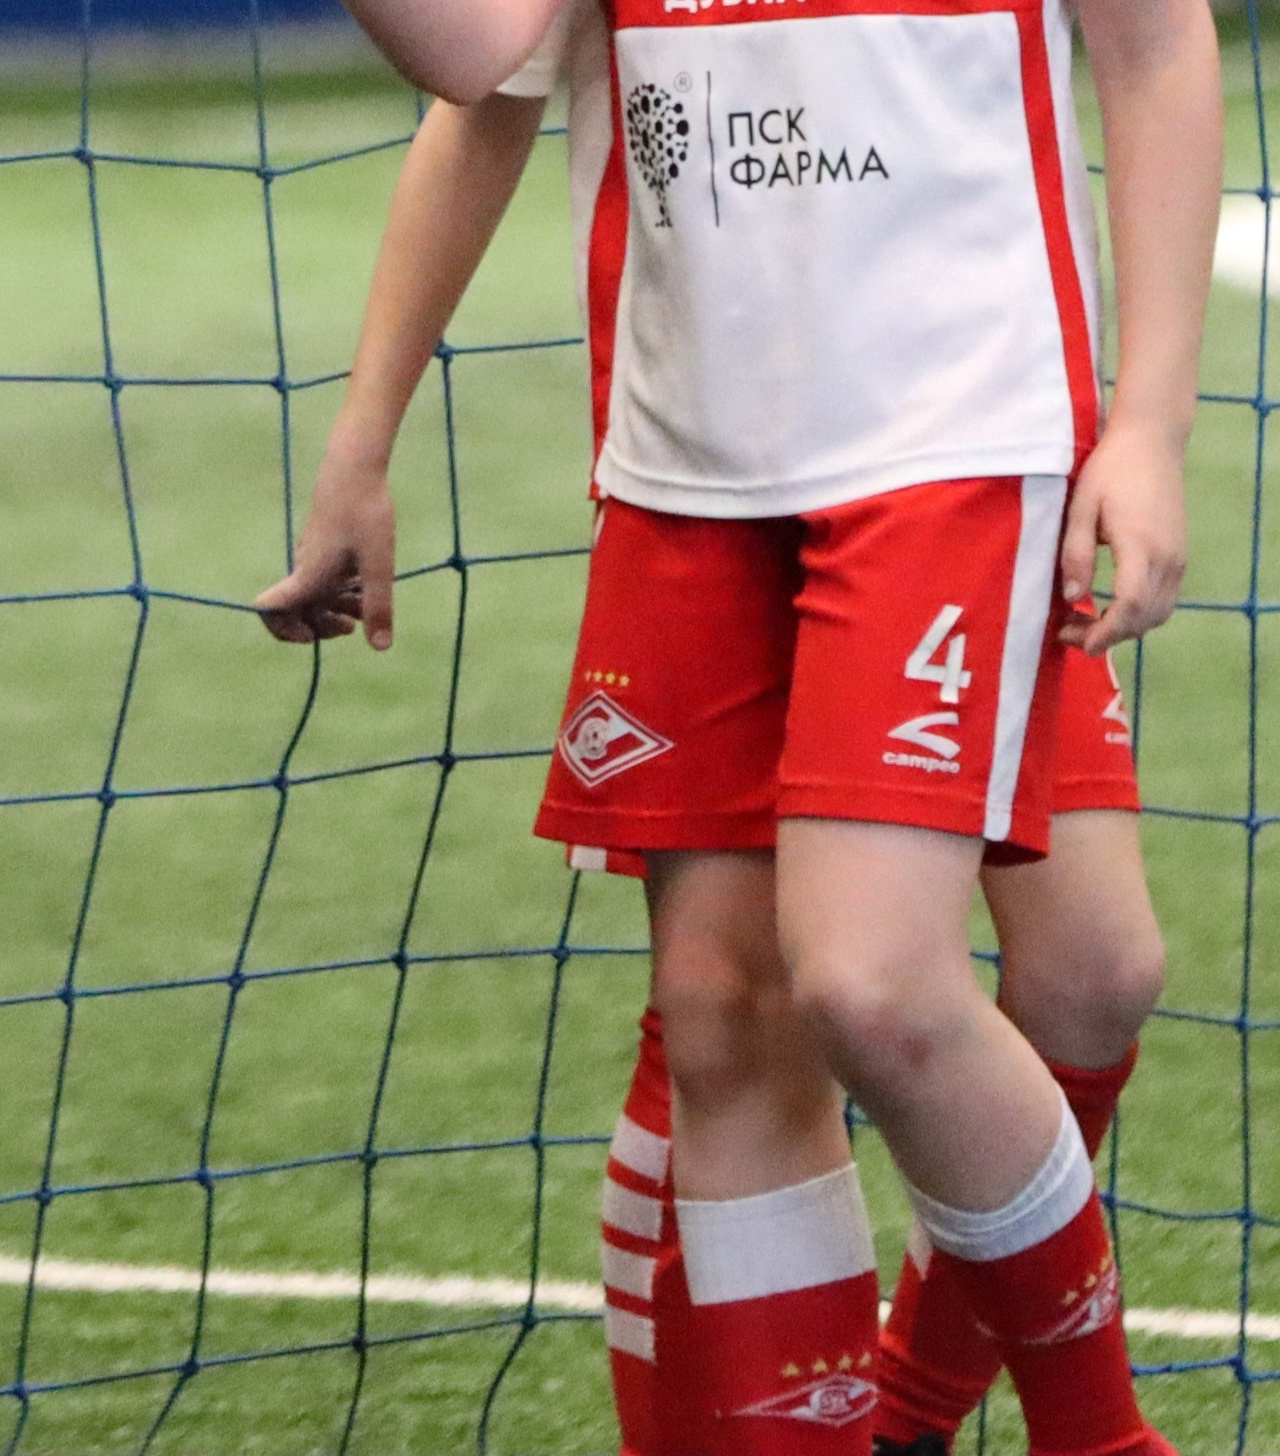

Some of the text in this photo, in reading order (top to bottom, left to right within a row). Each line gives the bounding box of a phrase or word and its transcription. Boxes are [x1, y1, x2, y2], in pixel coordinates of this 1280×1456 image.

[728, 107, 807, 148] ПСК
[730, 145, 890, 190] ФАРМА
[904, 604, 973, 704] 4
[882, 751, 961, 775] campeo
